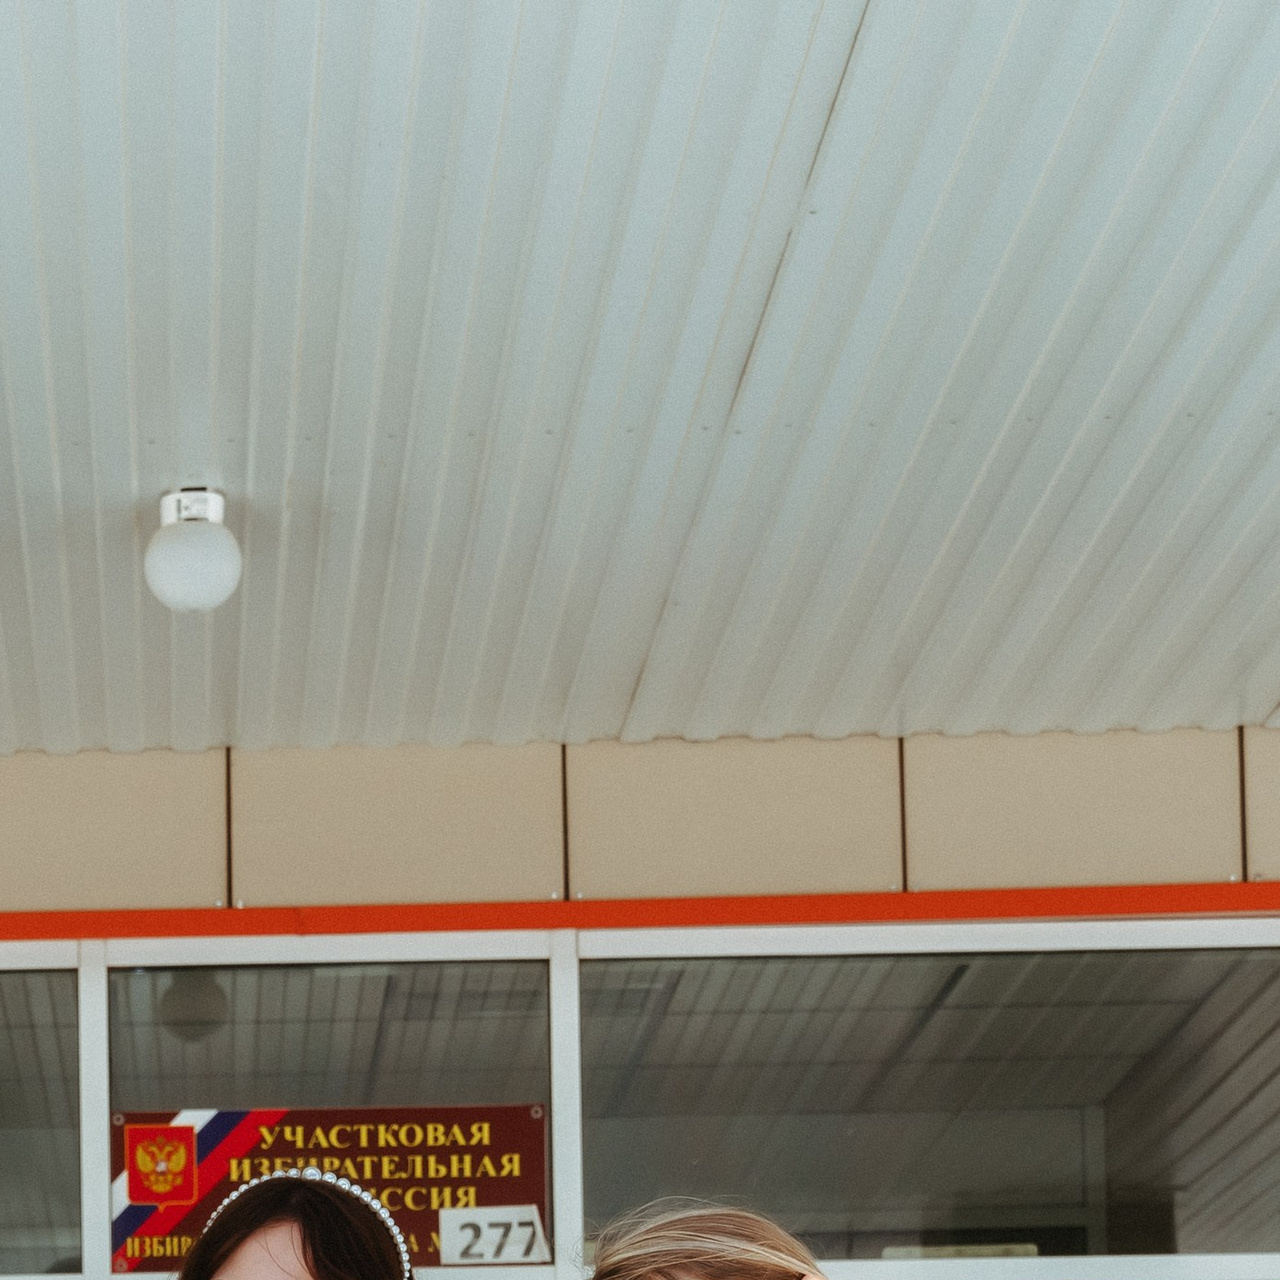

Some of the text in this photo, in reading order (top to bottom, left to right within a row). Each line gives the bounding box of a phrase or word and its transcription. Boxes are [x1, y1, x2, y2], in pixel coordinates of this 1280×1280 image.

[259, 1122, 490, 1150] УЧАСТКОВАЯ
[371, 1186, 476, 1211] ССИЯ
[460, 1221, 536, 1258] 277
